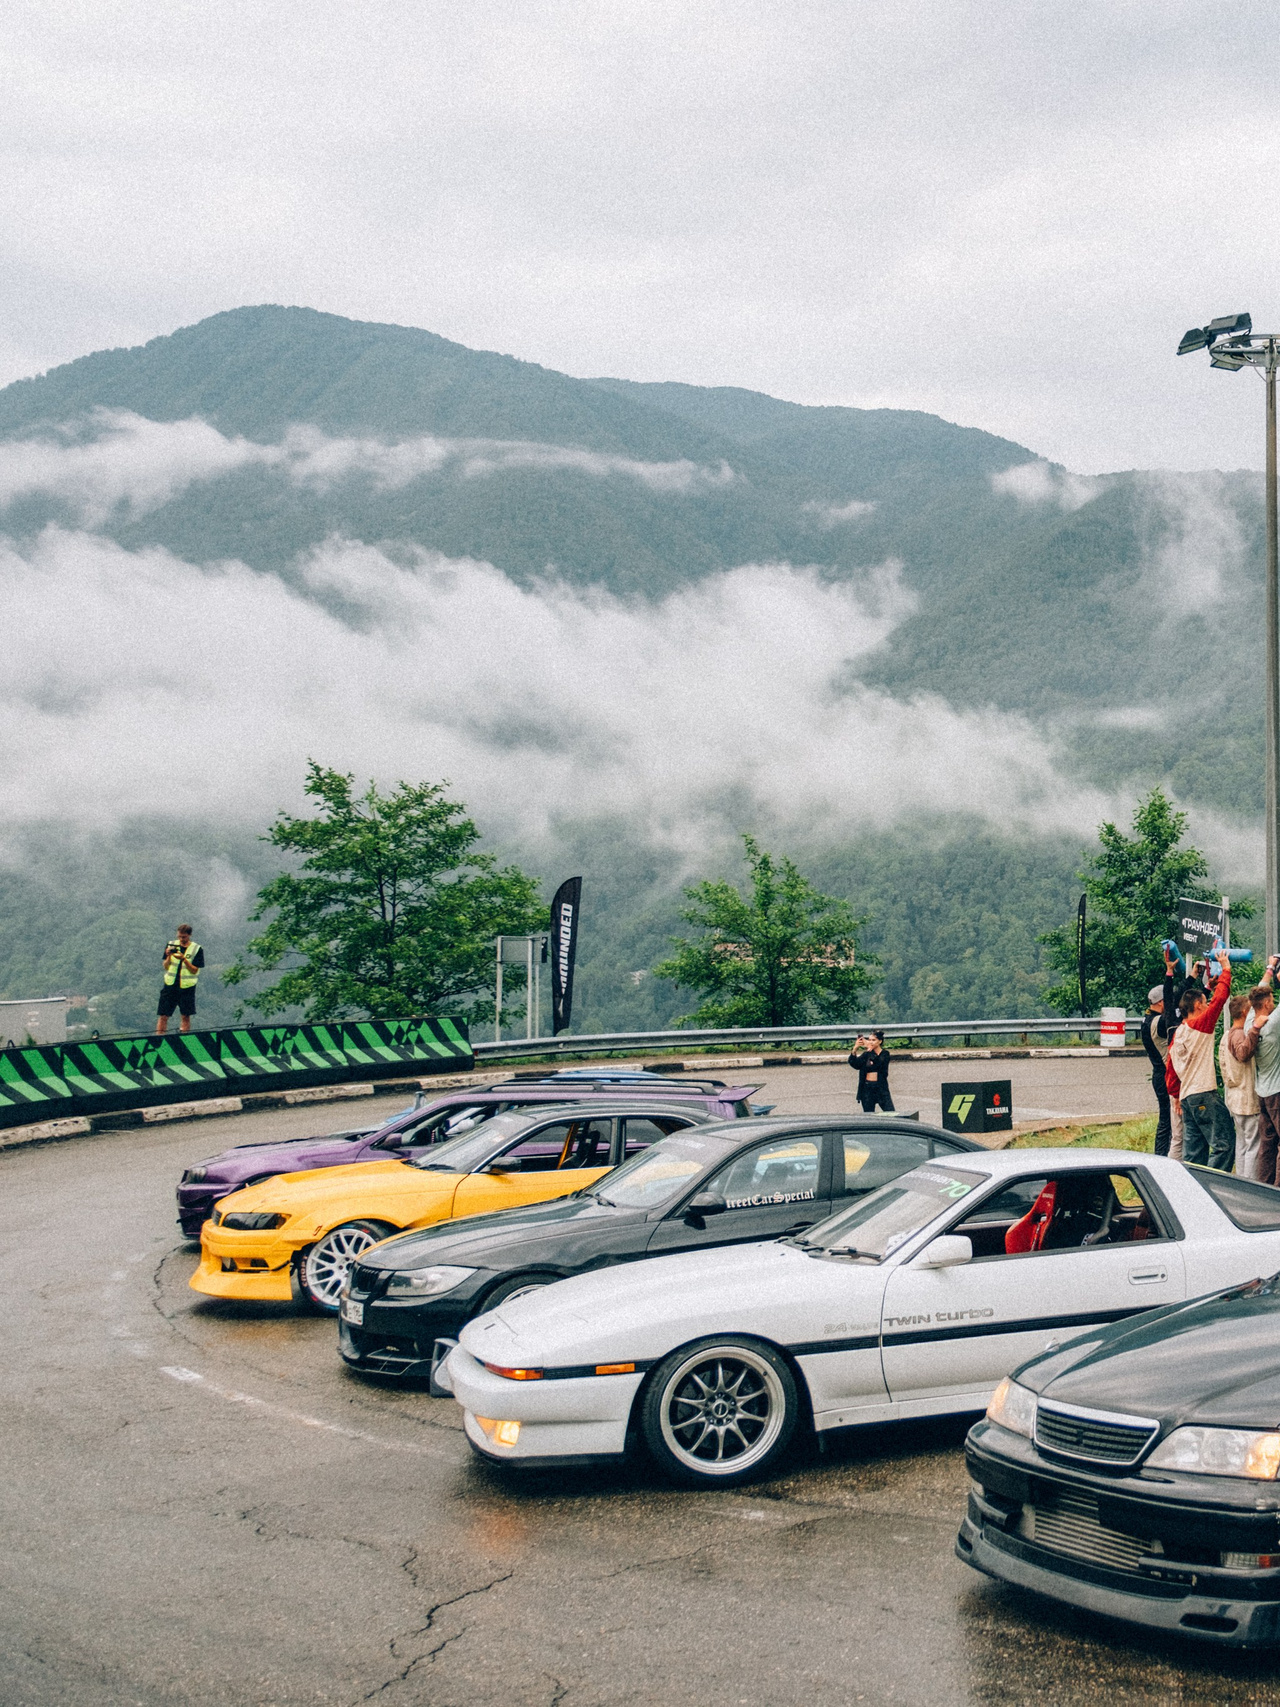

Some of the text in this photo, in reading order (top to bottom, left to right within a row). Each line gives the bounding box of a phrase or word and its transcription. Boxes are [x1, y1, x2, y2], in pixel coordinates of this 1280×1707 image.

[559, 902, 573, 995] OUNDED
[726, 1187, 815, 1209] treetCarSpecial
[939, 1180, 972, 1198] 70
[883, 1313, 931, 1327] TWIN
[935, 1307, 994, 1322] turbo
